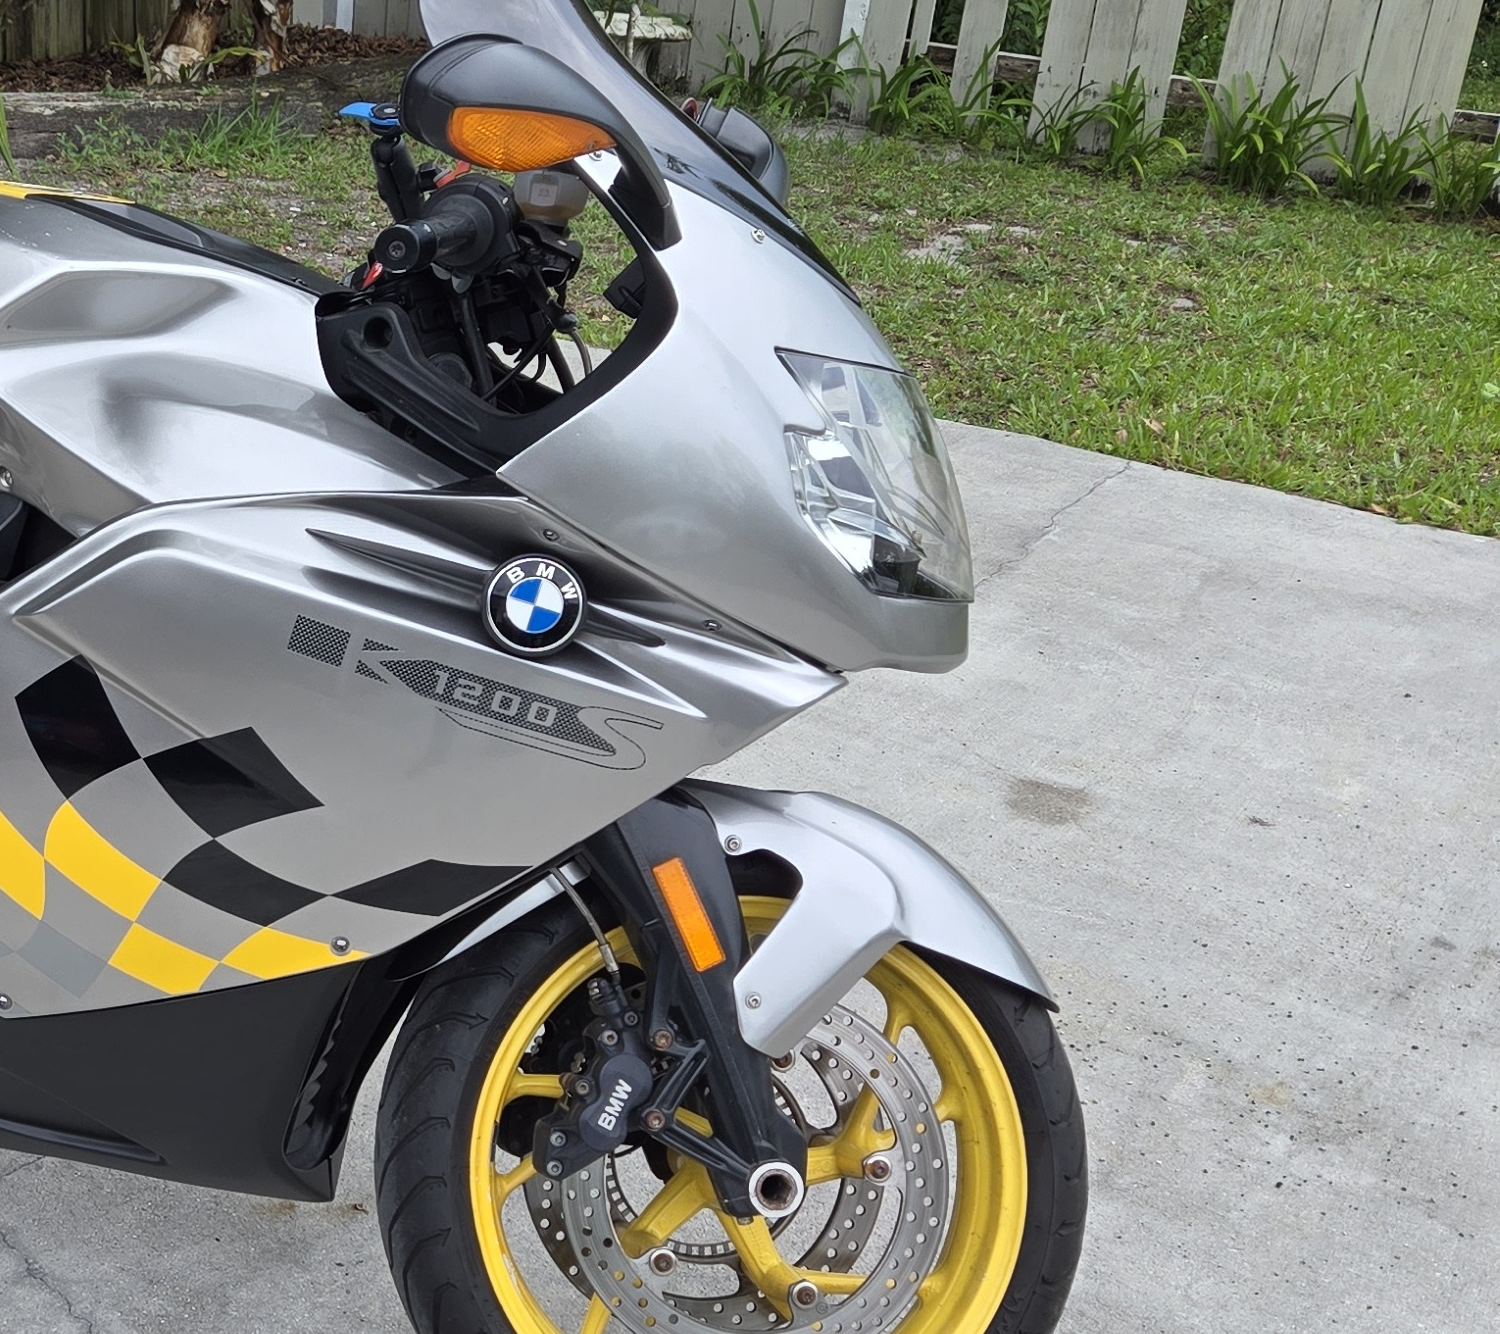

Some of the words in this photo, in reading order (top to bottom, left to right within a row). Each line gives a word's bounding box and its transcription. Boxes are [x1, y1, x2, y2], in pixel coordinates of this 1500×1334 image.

[506, 562, 578, 600] BMW
[434, 669, 558, 727] 1200
[598, 1079, 632, 1131] BMW
